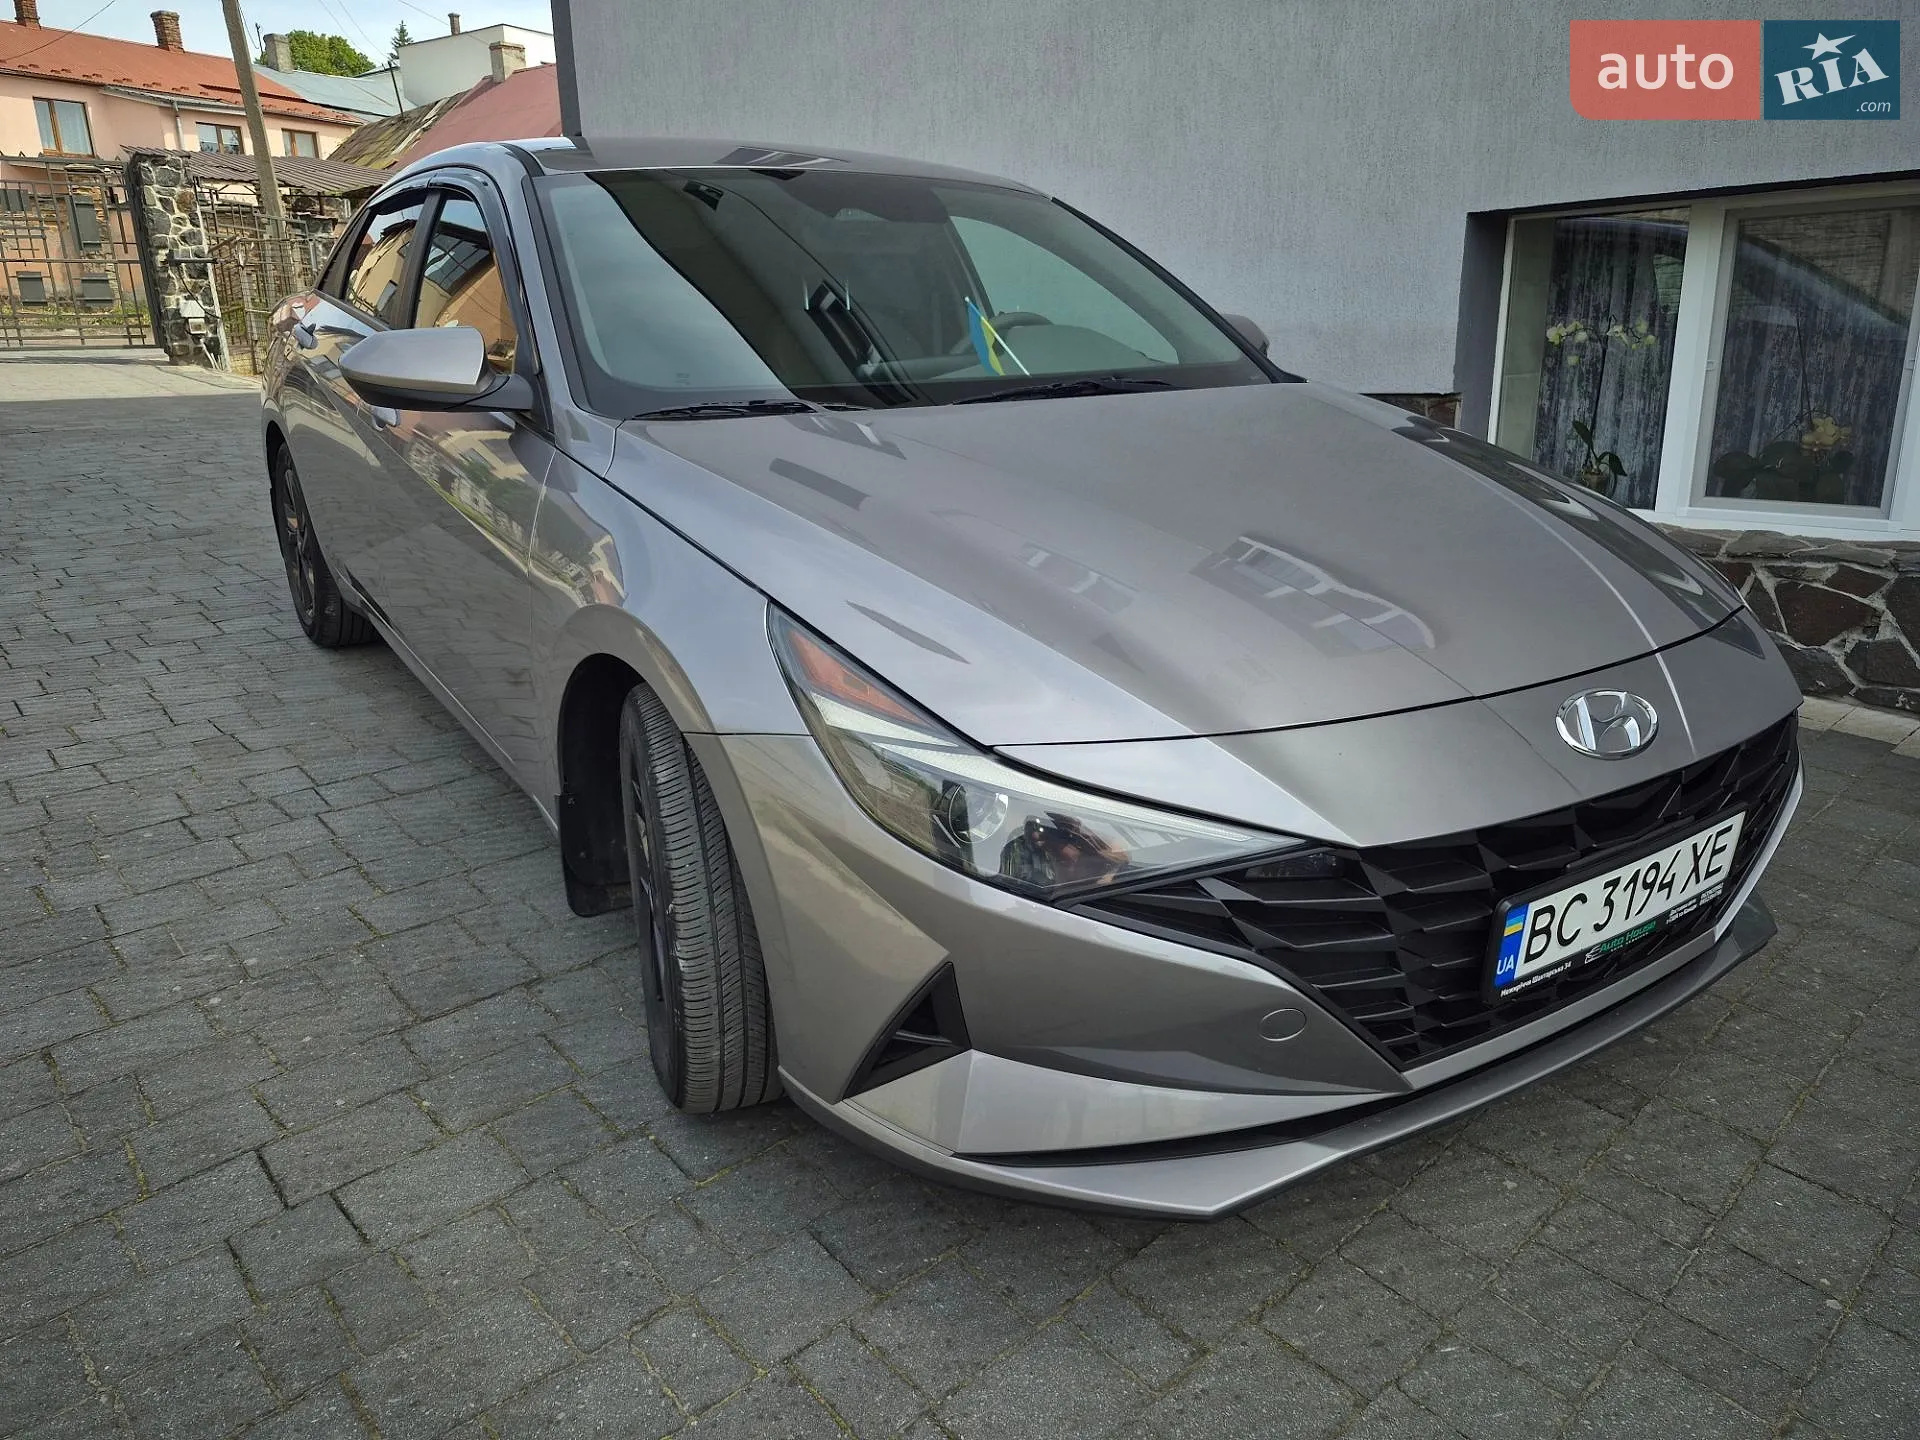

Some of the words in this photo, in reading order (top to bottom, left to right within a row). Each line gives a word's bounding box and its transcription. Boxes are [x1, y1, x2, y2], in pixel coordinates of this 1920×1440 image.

[1523, 893, 1588, 965] BC
[1593, 849, 1682, 932] 3194
[1680, 824, 1734, 895] XE
[1496, 954, 1515, 975] UA
